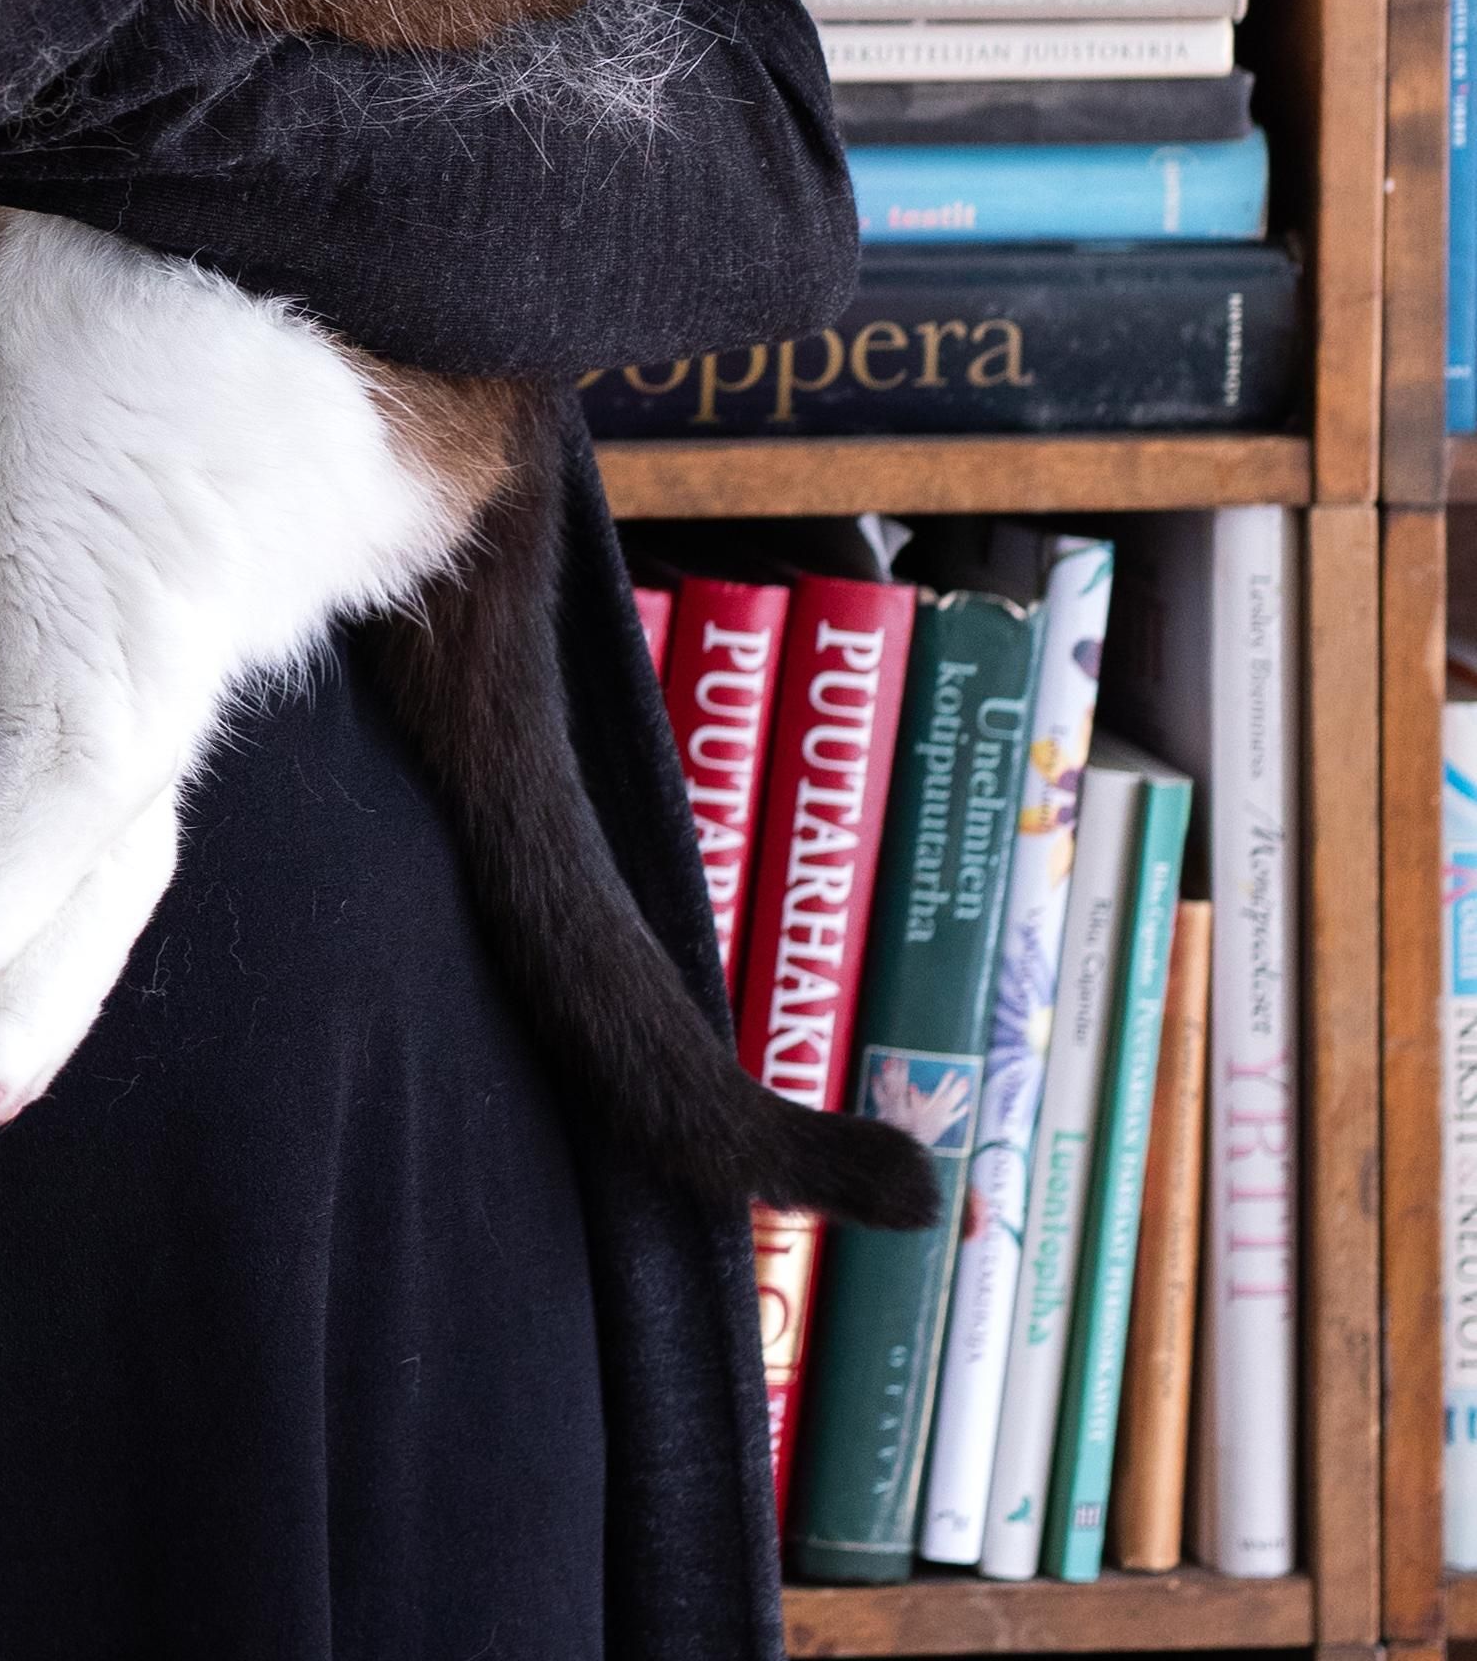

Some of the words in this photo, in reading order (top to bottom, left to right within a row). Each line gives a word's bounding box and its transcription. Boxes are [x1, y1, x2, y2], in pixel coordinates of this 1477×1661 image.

[574, 312, 1036, 425] oppera
[904, 657, 979, 945] kotipuutarha
[952, 692, 1028, 923] Unelmien
[1024, 1128, 1087, 1347] Luontopiha
